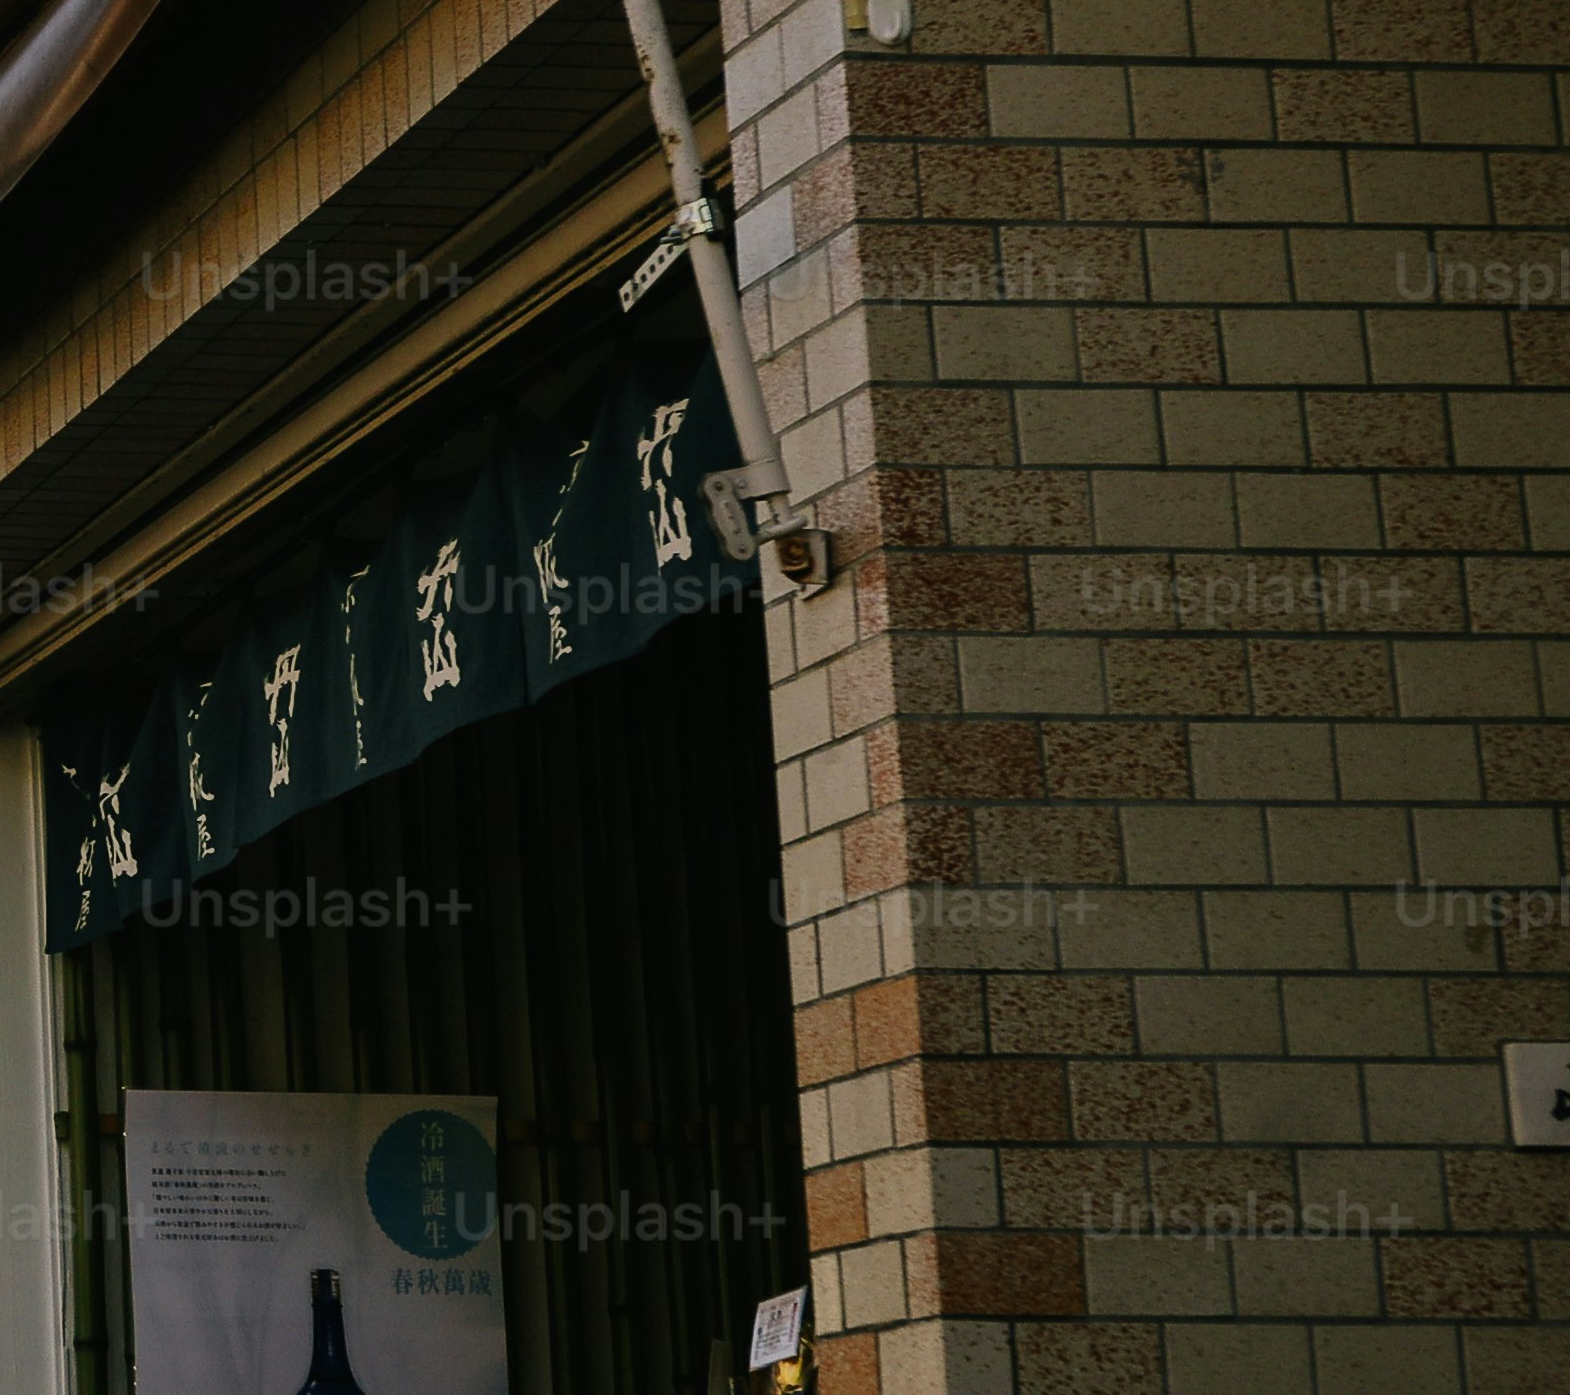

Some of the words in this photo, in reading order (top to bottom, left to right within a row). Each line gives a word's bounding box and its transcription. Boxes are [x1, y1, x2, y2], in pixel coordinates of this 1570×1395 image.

[419, 1120, 451, 1252] 冷酒誕生
[390, 1267, 495, 1299] 春秋萬歳
